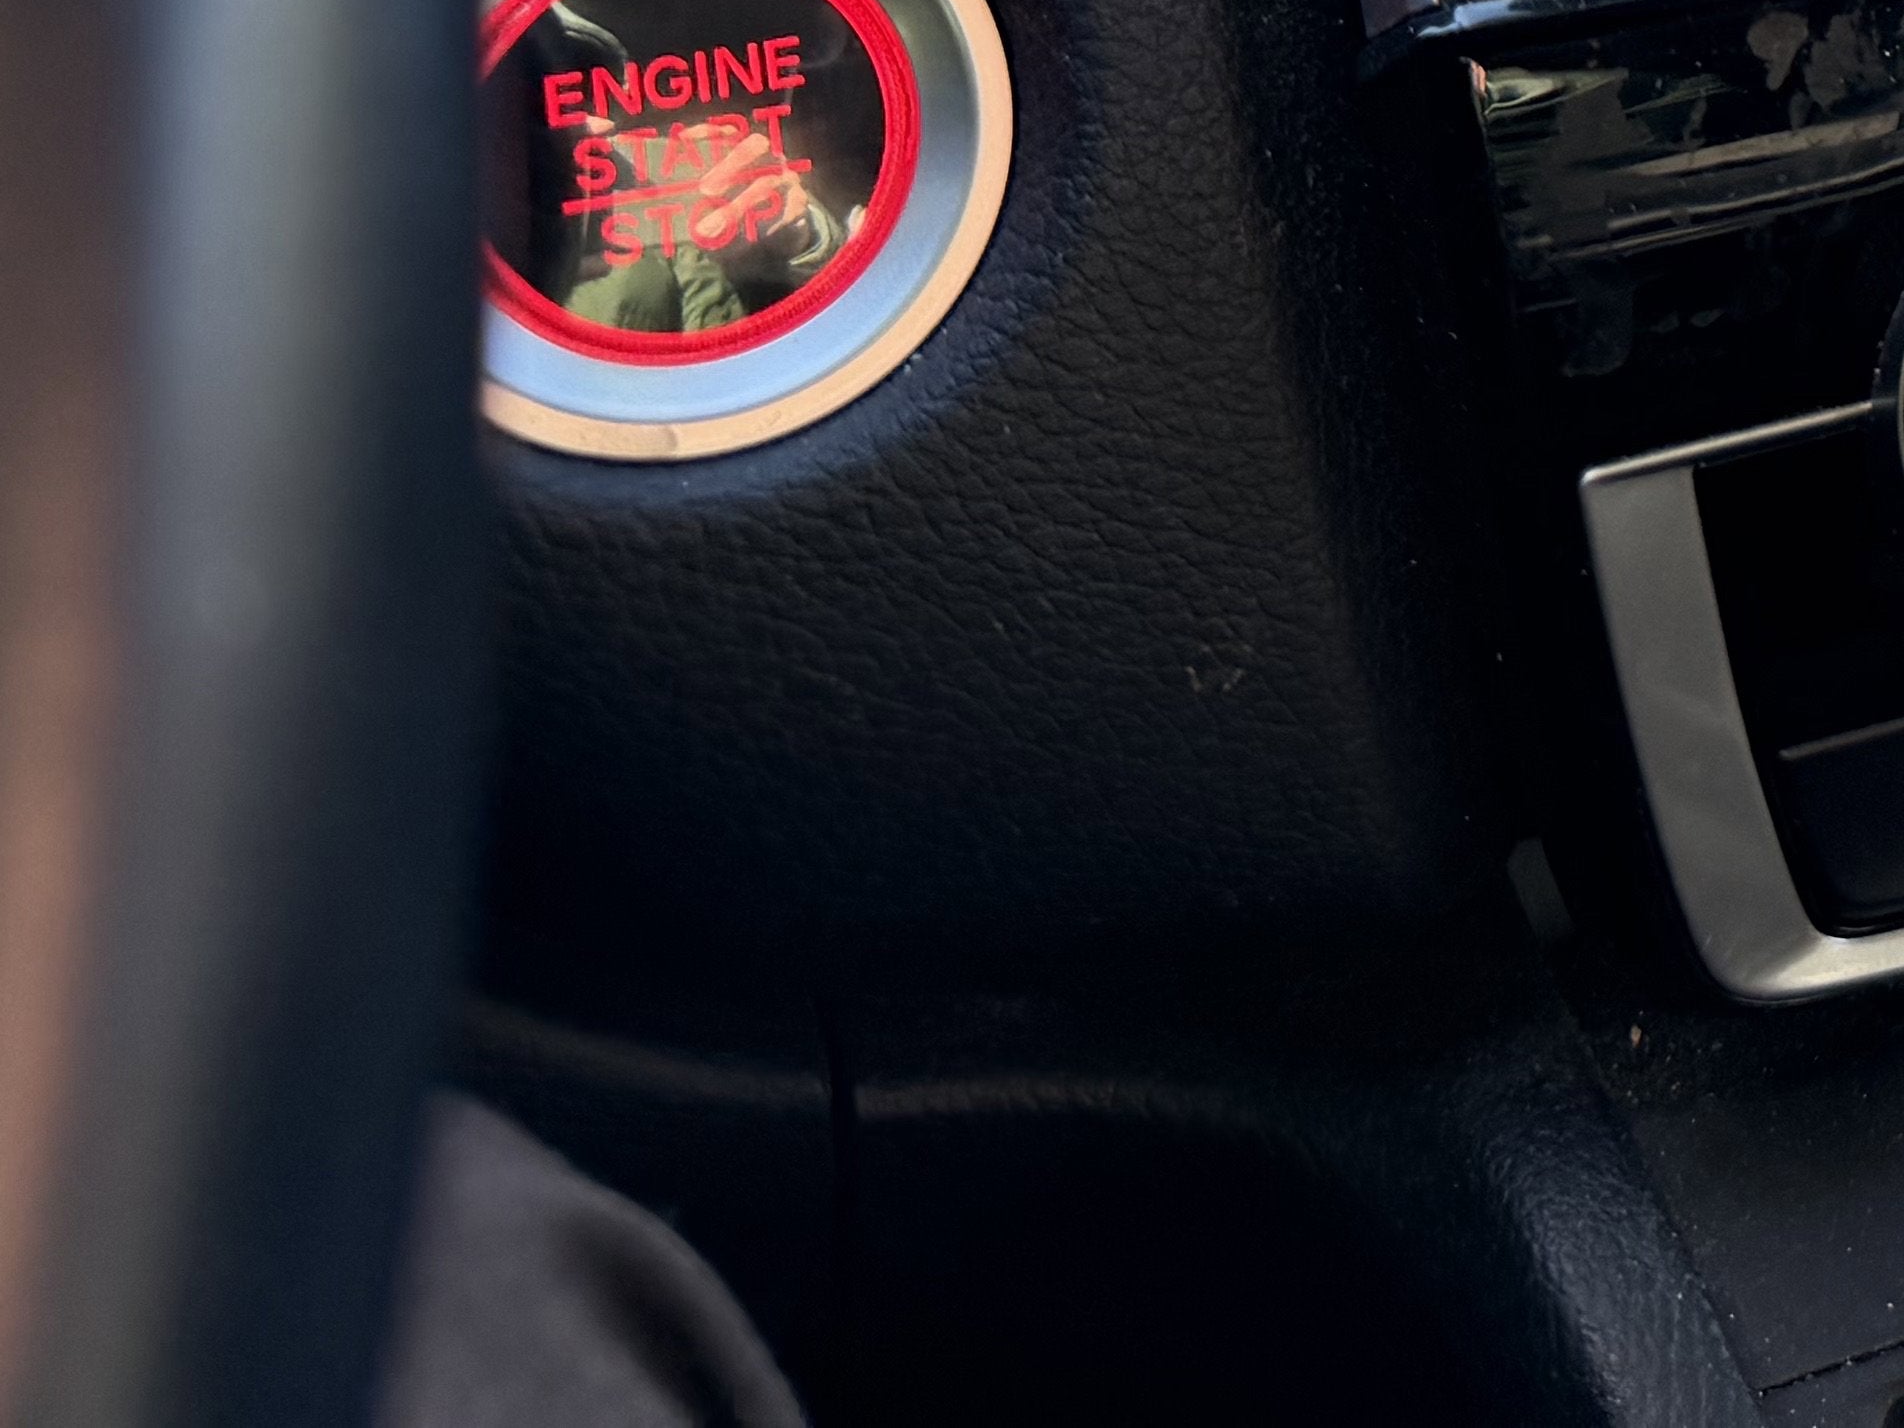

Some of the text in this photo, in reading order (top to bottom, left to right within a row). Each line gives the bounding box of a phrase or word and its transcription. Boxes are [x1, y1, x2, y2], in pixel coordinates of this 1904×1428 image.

[543, 35, 806, 129] ENGINE
[573, 104, 792, 191] START
[600, 191, 785, 268] STOP
